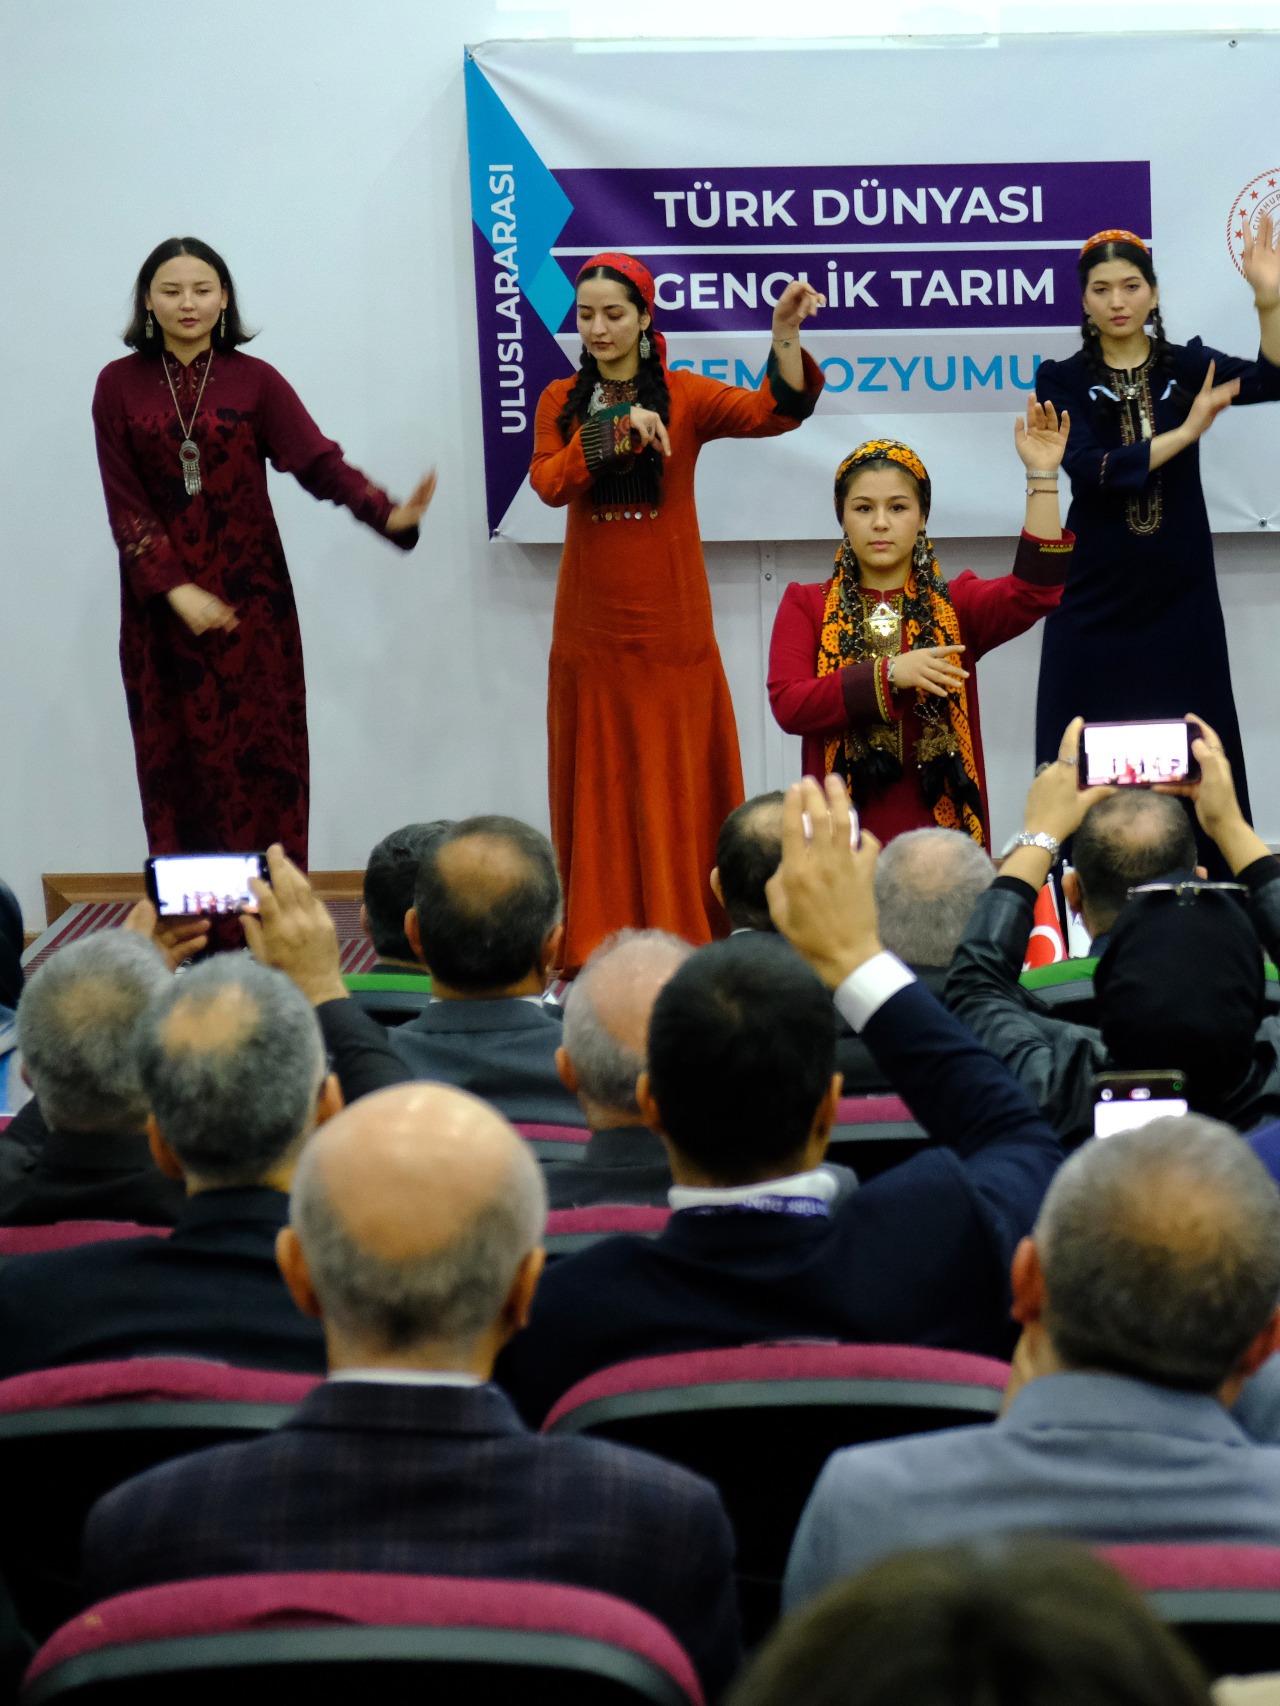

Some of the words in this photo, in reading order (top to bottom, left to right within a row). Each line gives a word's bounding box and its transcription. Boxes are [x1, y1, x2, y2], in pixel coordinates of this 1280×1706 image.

[653, 181, 798, 228] TÜRK
[812, 179, 1043, 226] DÜNYASI
[489, 164, 527, 433] ULUSLARARASI
[891, 268, 1054, 307] TARIM
